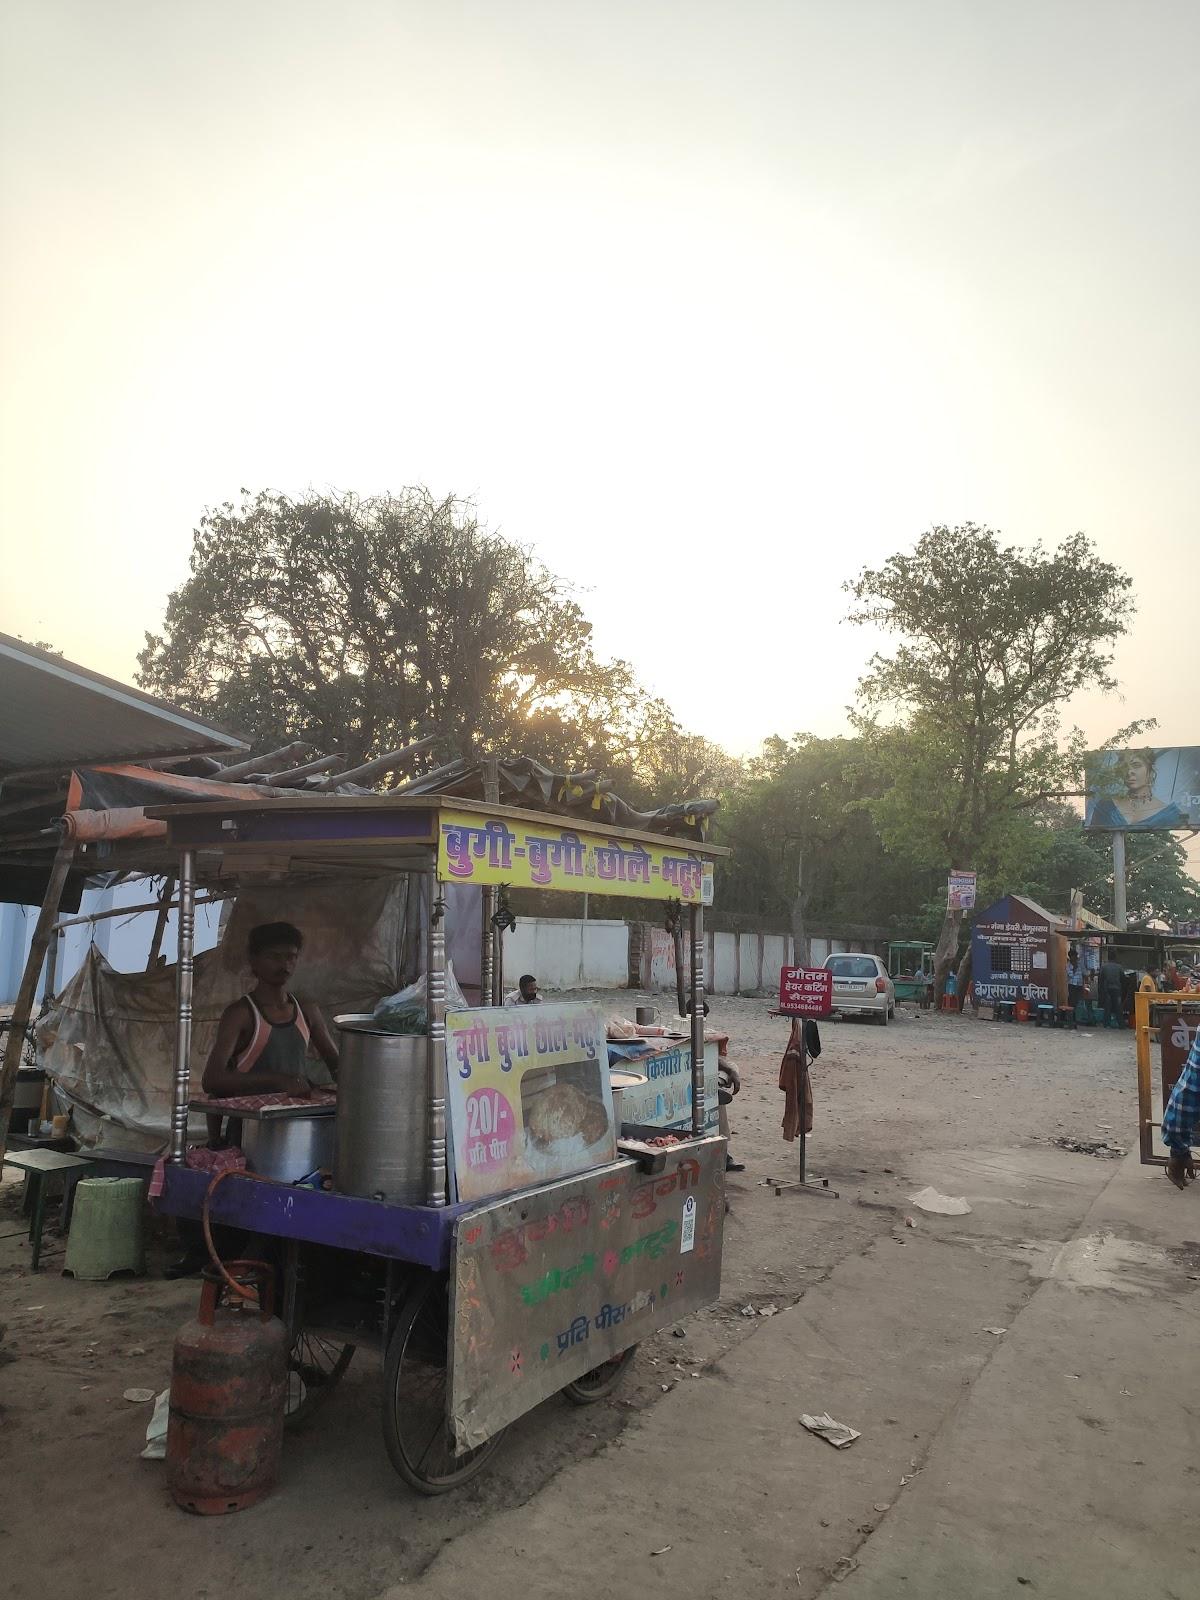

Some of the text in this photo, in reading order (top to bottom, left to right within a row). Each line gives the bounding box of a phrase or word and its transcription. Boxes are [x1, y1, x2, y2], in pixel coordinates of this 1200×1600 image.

[975, 980, 1049, 1001] बेगूसराय पुलिस
[467, 1092, 507, 1138] 20/-
